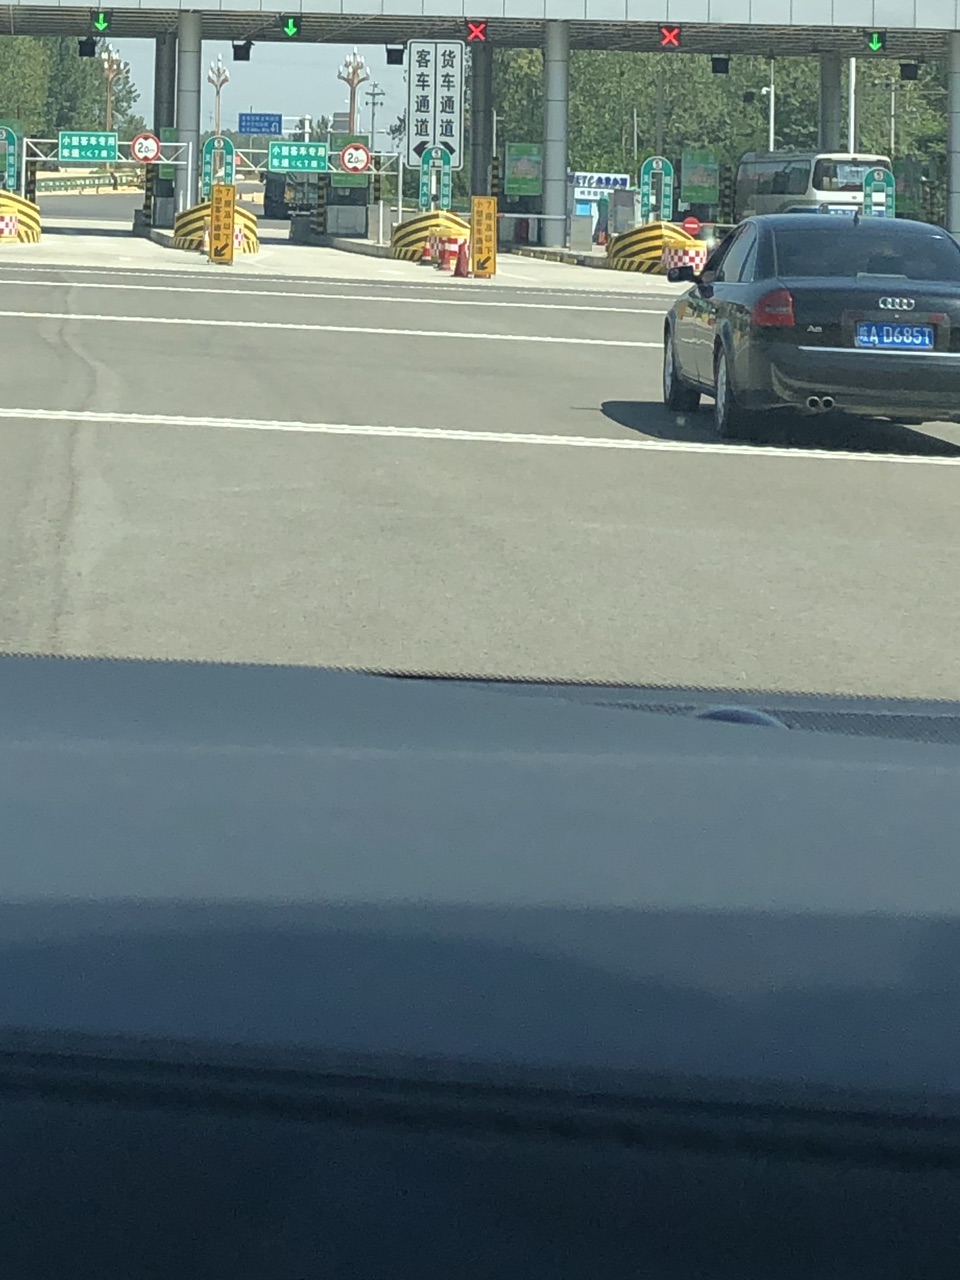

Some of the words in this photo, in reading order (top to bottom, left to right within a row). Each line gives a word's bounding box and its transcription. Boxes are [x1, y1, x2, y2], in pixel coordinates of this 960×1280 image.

[415, 49, 431, 137] 客车通道
[439, 49, 456, 138] 货车通道
[62, 136, 115, 146] 小型客车专用
[272, 146, 326, 157] 小型客车专用
